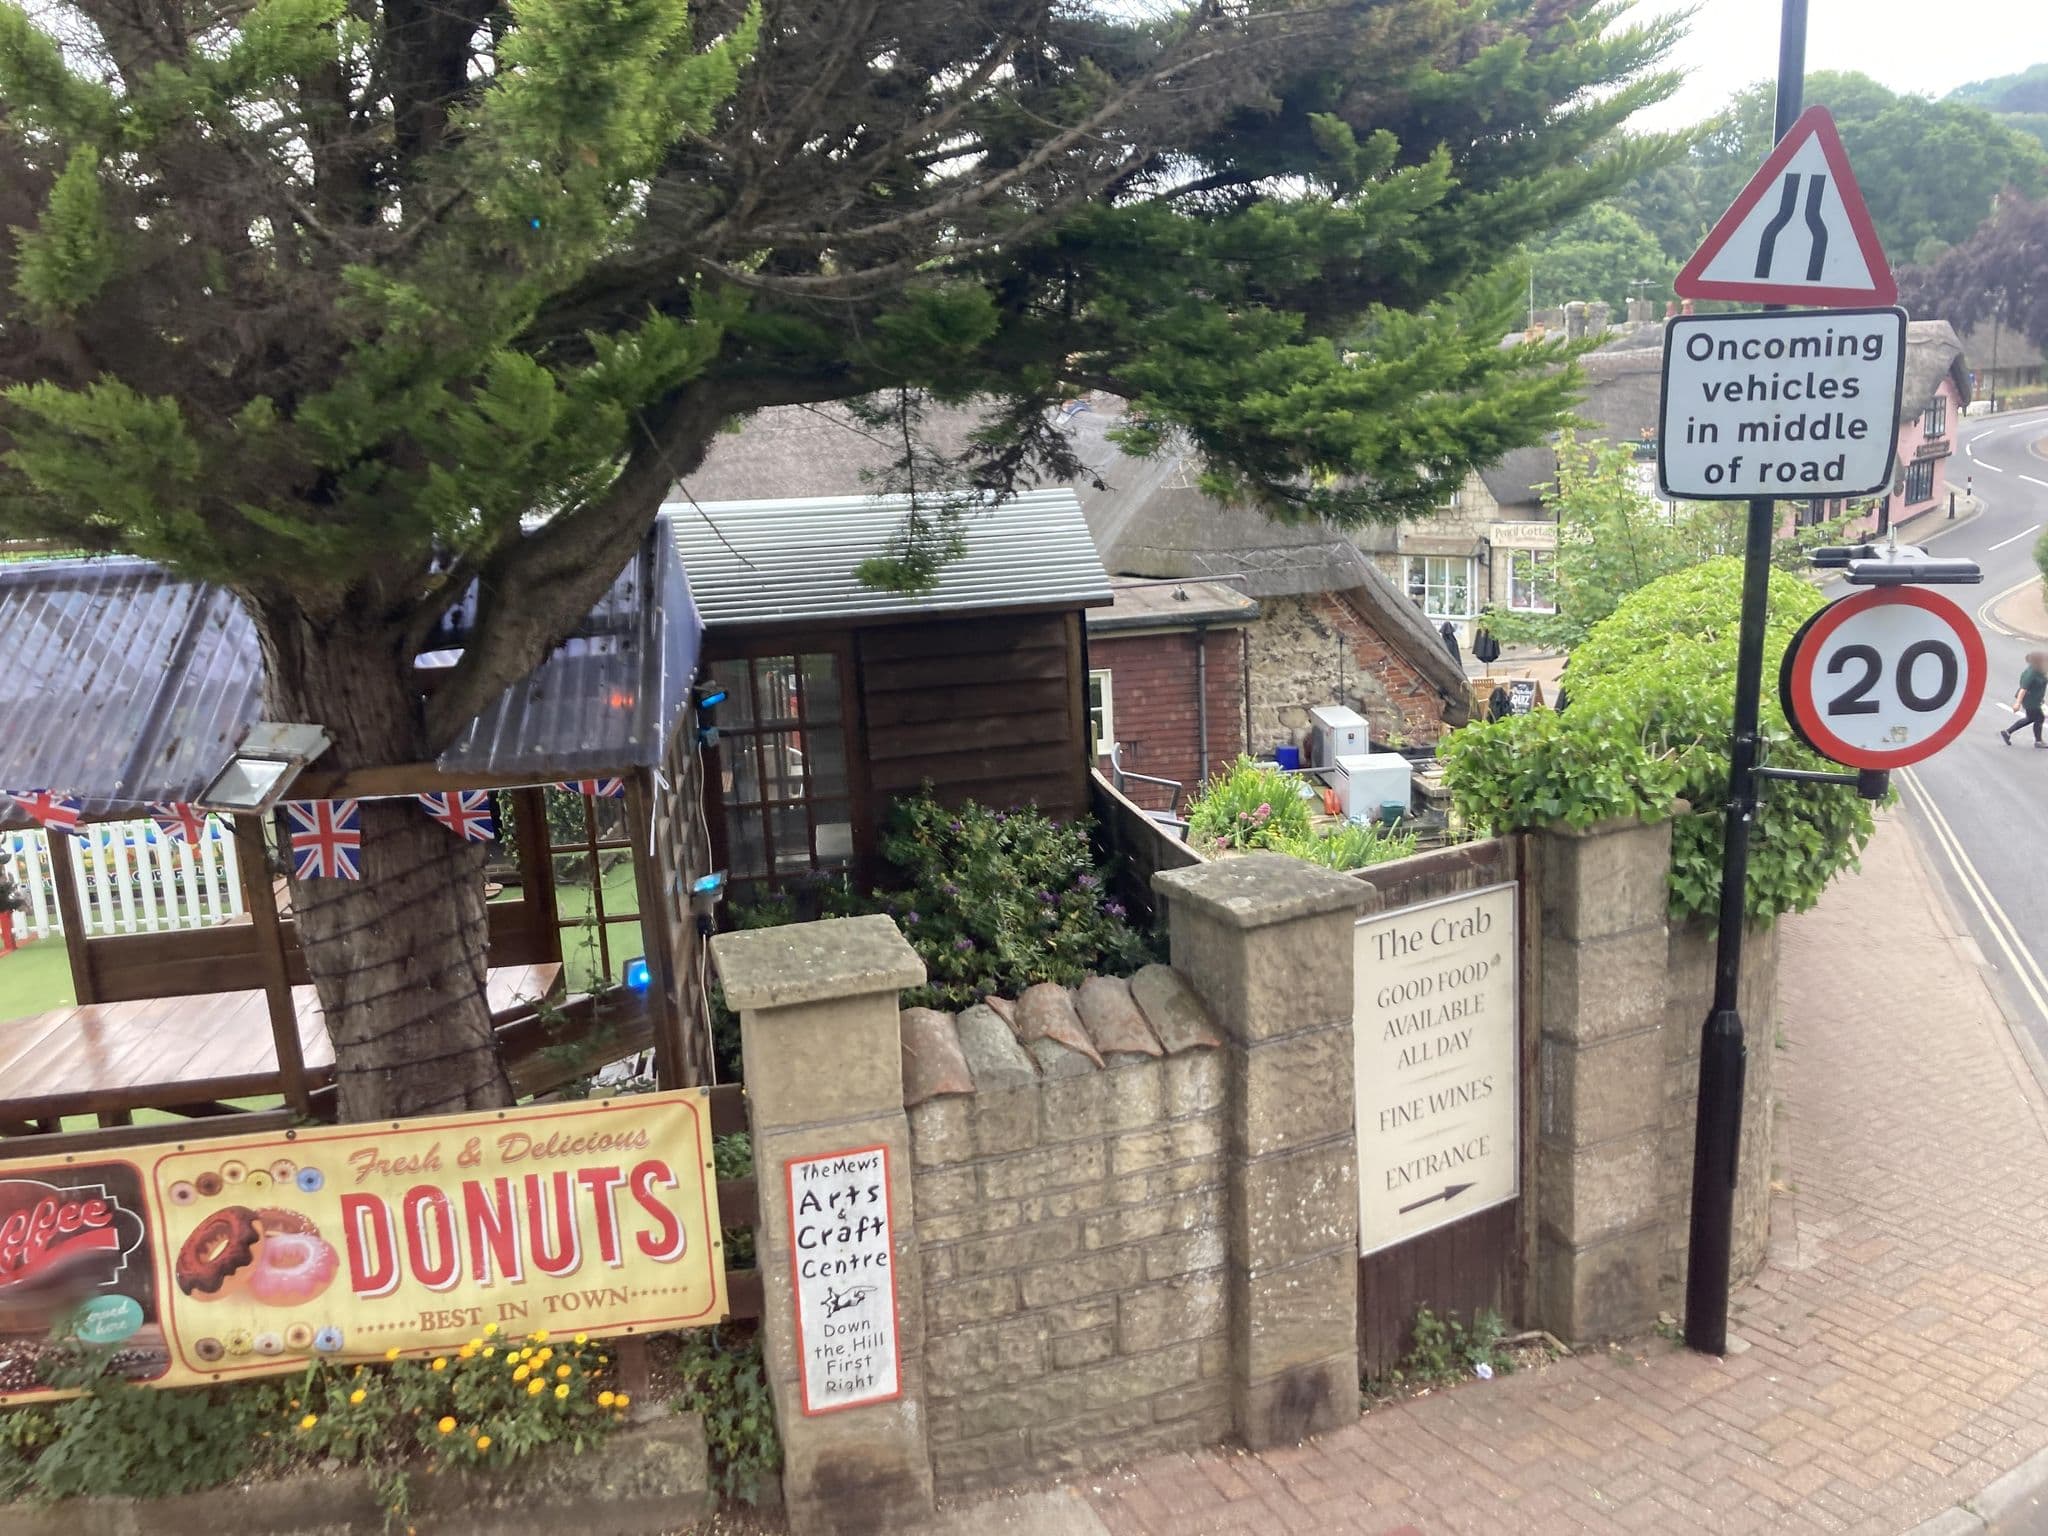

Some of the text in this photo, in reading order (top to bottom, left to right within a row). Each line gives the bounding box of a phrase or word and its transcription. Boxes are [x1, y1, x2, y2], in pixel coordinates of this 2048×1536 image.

[1686, 328, 1883, 361] Oncoming
[1702, 372, 1860, 402] vehicles
[1686, 412, 1868, 443] in middle
[1704, 454, 1845, 484] of road
[1827, 639, 1958, 716] 20
[1372, 906, 1492, 961] The Crab
[1377, 960, 1489, 1009] GOOD FOOD
[1383, 993, 1485, 1041] AVAILABLE
[1397, 1029, 1475, 1070] ALL DAY
[1379, 1075, 1493, 1132] FINE WINES
[349, 1127, 650, 1185] Fresh & Delicious
[801, 1155, 879, 1182] The Mews
[1385, 1136, 1491, 1191] ENTRANCE
[799, 1184, 880, 1215] Arts
[837, 1208, 847, 1220] &
[341, 1158, 687, 1300] DONUTS
[797, 1215, 885, 1249] Craft
[802, 1251, 888, 1279] Centre
[499, 1299, 529, 1322] IN
[823, 1318, 870, 1338] Down
[814, 1331, 884, 1359] the Hill
[826, 1354, 872, 1375] First
[825, 1374, 874, 1393] Right
